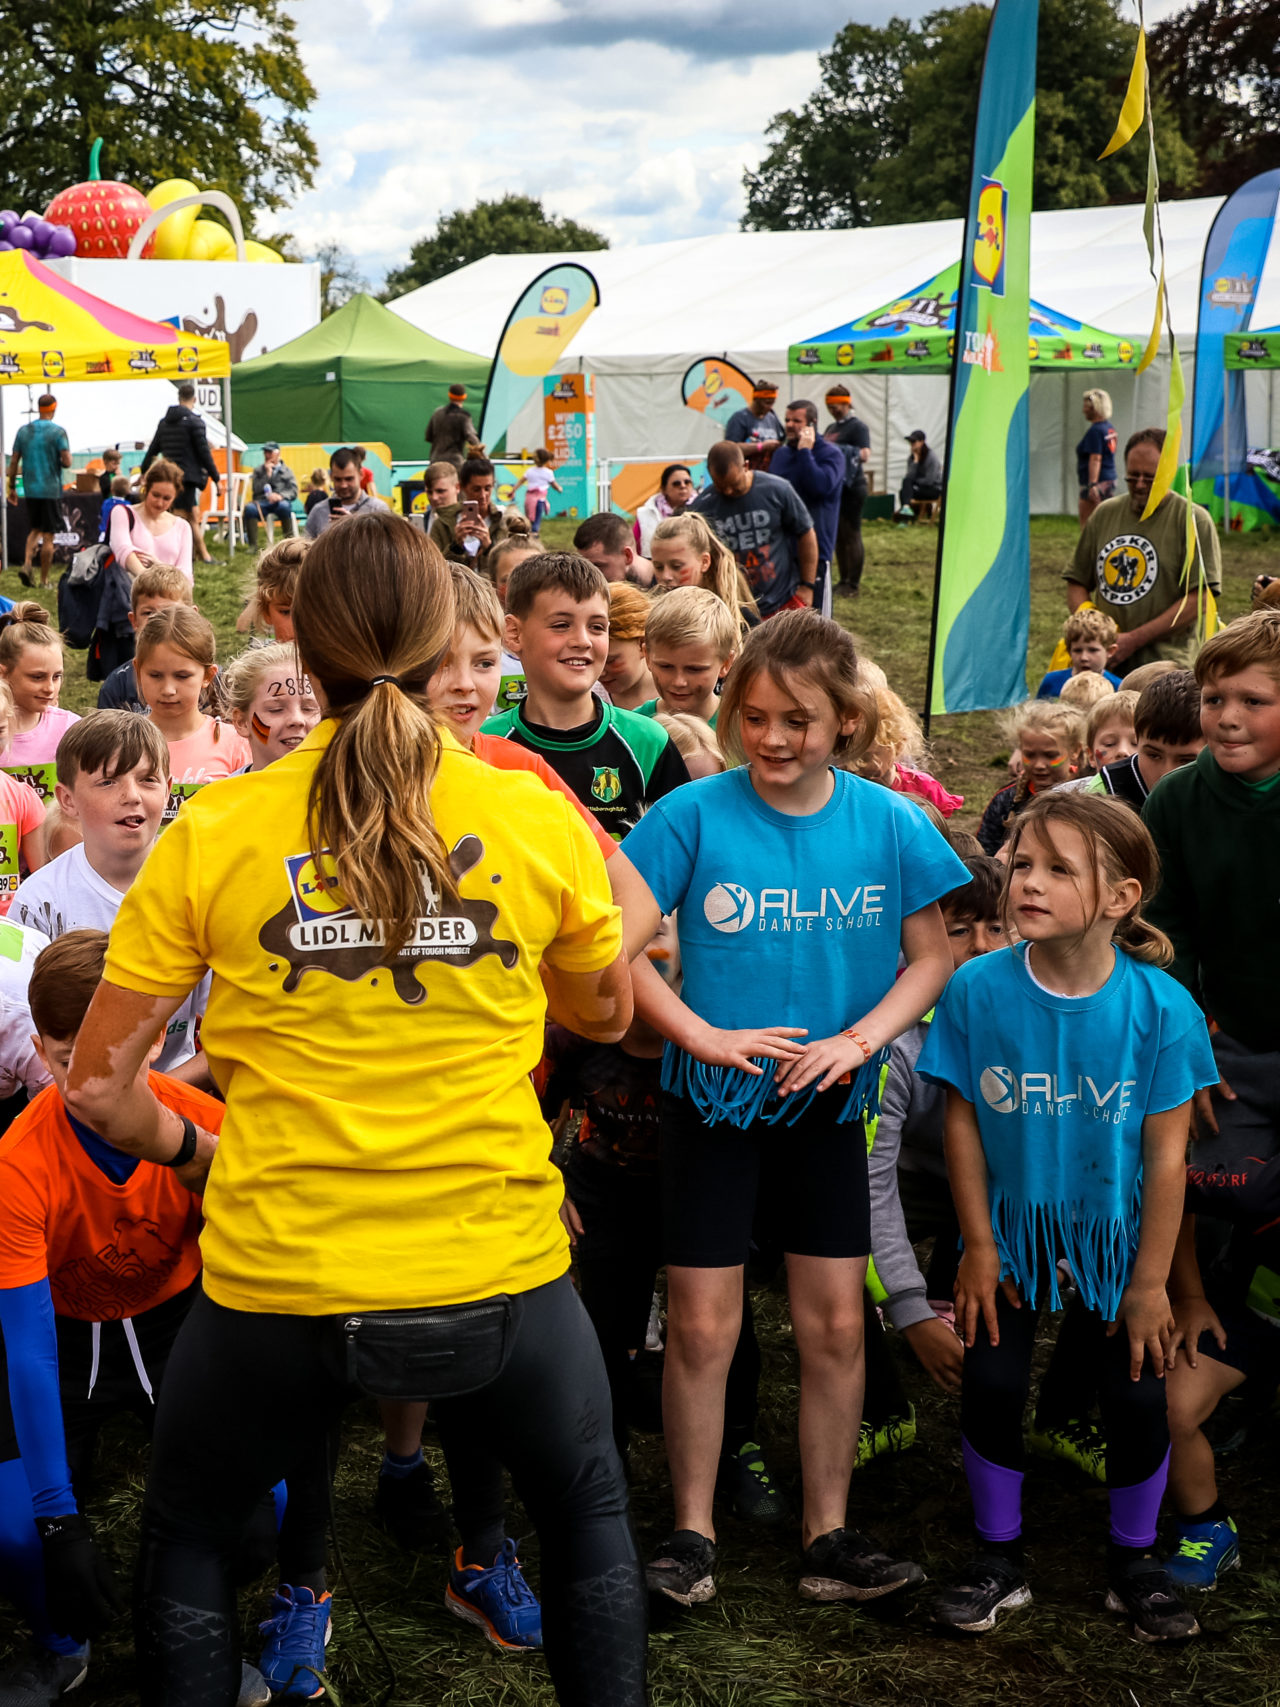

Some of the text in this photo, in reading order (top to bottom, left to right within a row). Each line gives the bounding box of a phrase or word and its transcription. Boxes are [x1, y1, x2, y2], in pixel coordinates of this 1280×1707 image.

[548, 423, 583, 439] £250
[715, 509, 771, 535] MUD
[759, 885, 886, 918] ALIVE
[759, 913, 882, 932] DANCE SCHOOL
[300, 924, 351, 946] LIDL
[411, 947, 421, 955] OF
[421, 947, 443, 955] TOUGH
[1021, 1073, 1136, 1107] ALIVE
[1022, 1101, 1072, 1117] DANCE
